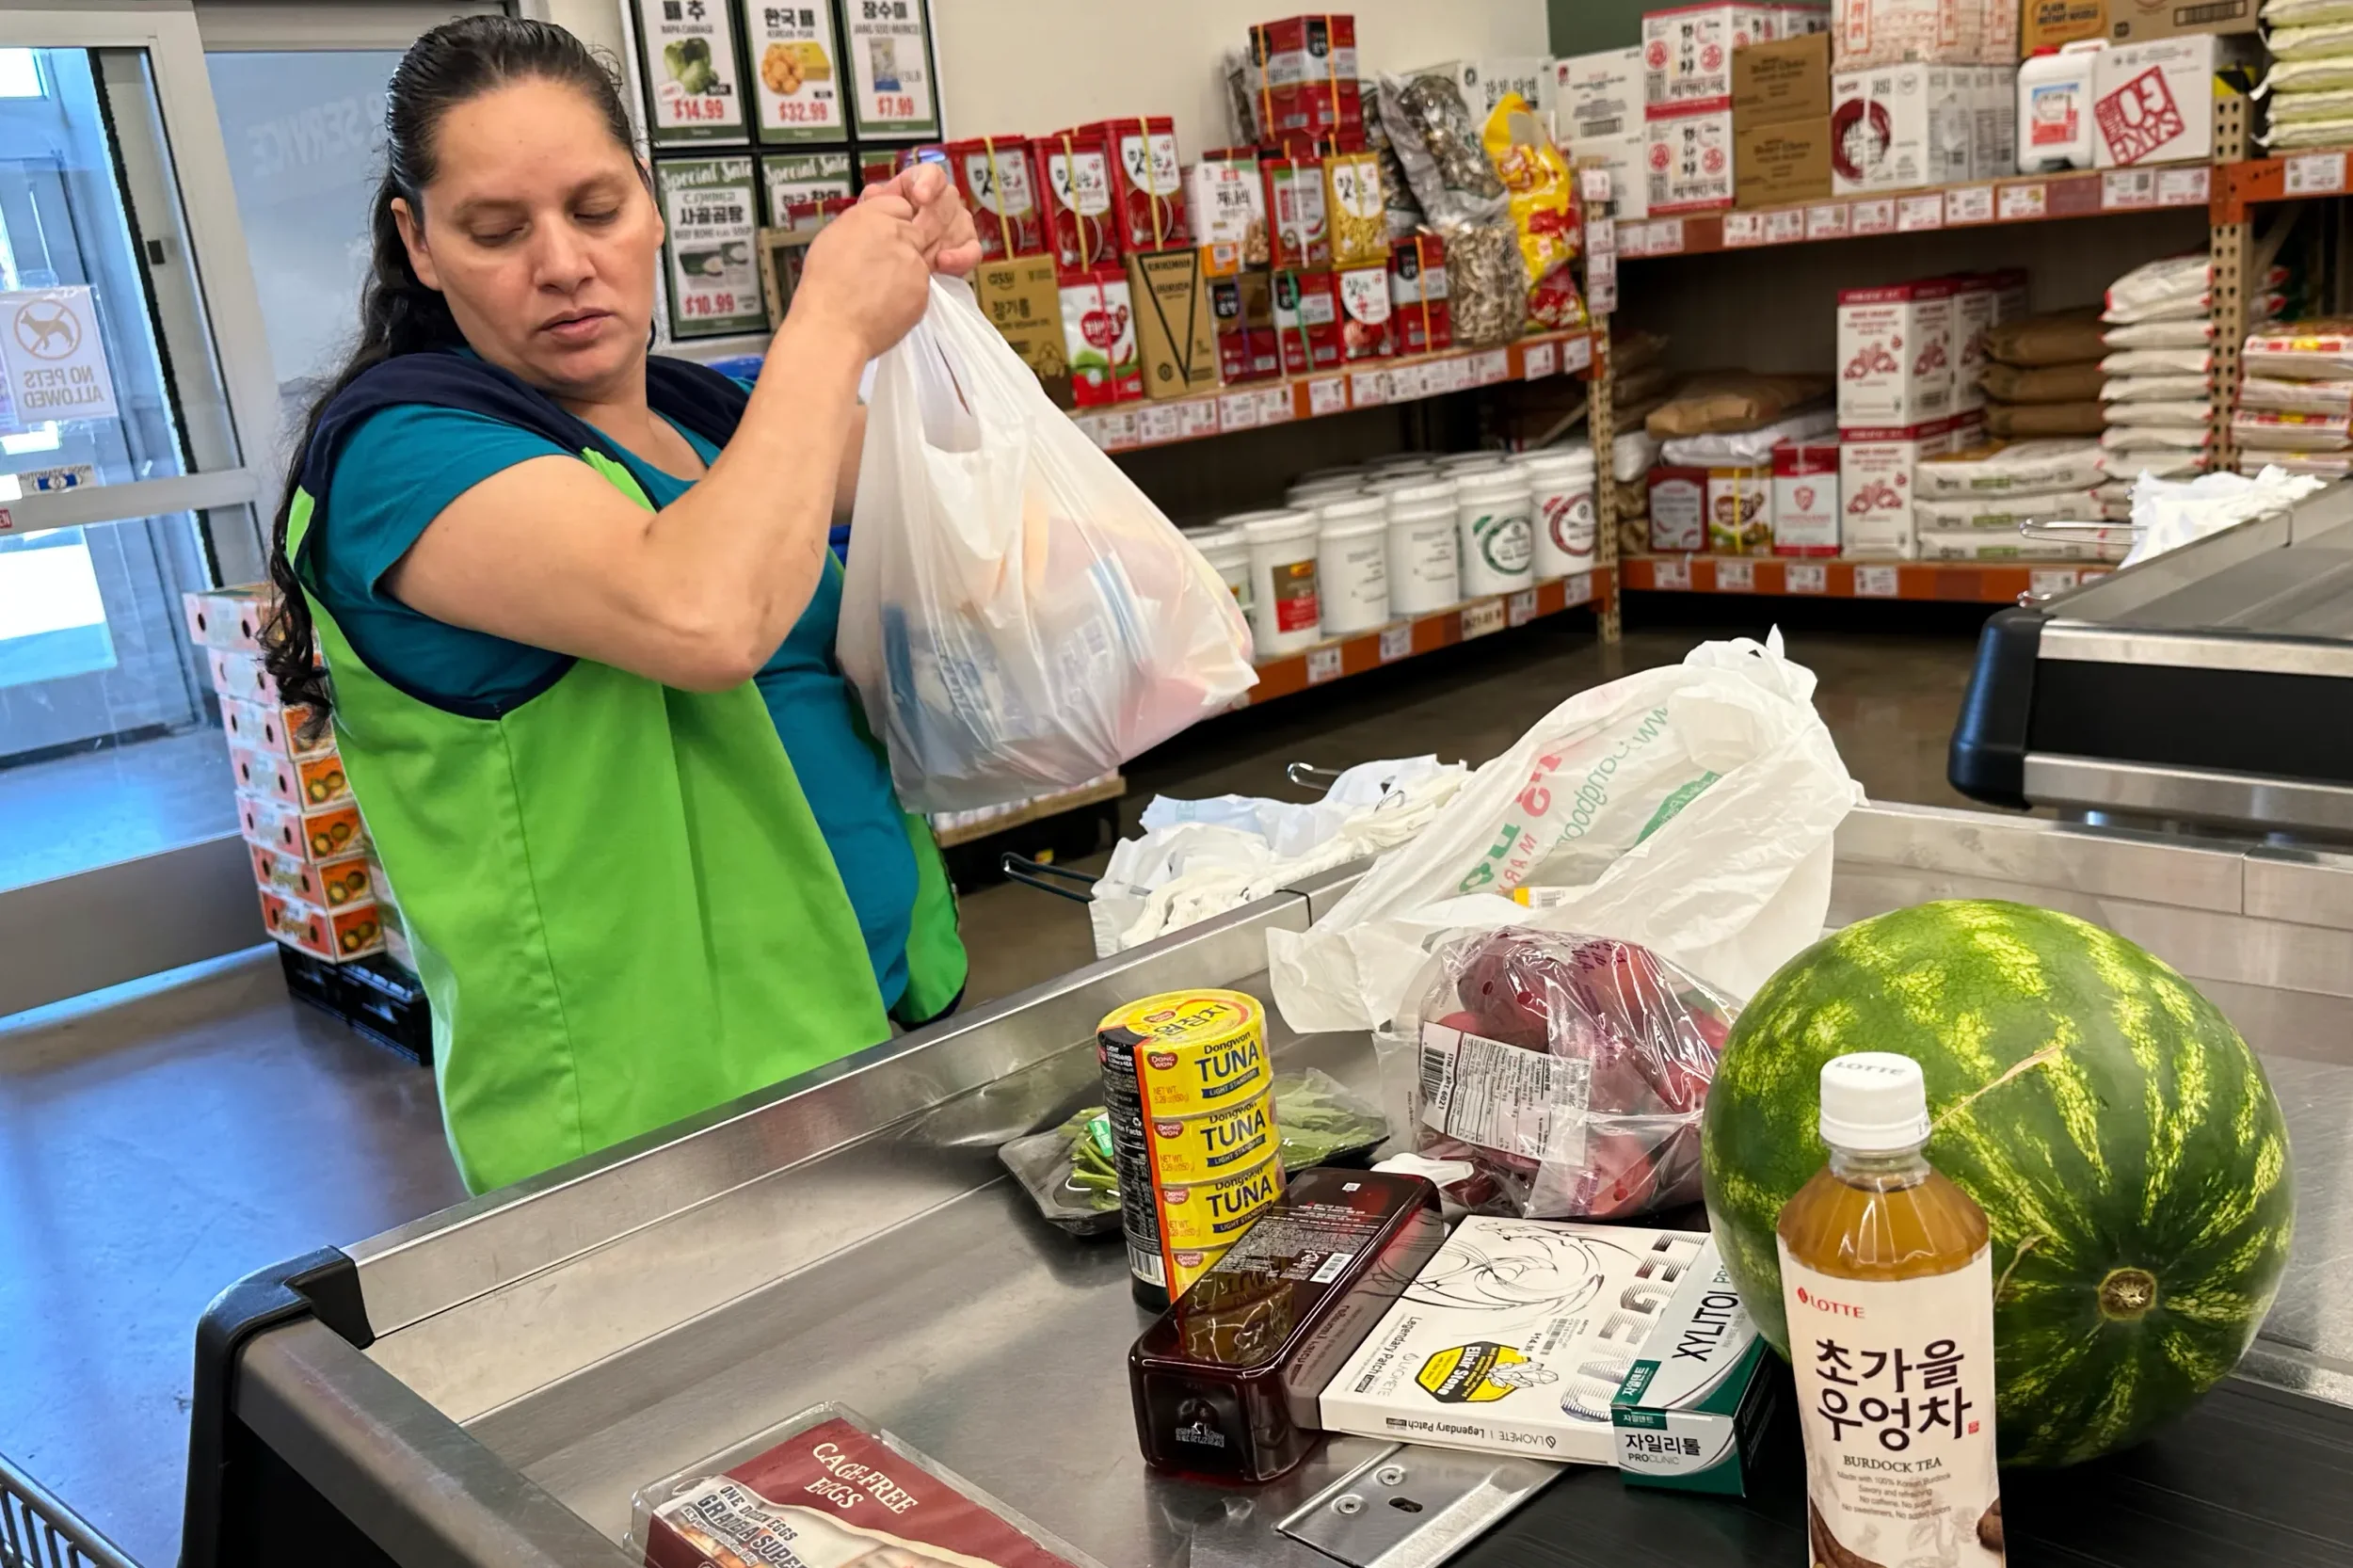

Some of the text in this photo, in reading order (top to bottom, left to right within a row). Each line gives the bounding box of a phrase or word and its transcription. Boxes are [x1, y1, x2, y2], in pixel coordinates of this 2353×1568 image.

[764, 8, 795, 27] 한국
[673, 98, 725, 120] $14.99
[876, 95, 915, 118] $7.99
[660, 160, 753, 191] Special Sale
[763, 154, 850, 186] Special Sale
[685, 293, 735, 316] $10.99
[1203, 1032, 1252, 1055] Dongwon
[1151, 1054, 1176, 1063] DONG
[1194, 1040, 1260, 1081] TUNA
[1446, 1053, 1454, 1068] ITM.
[1835, 1061, 1906, 1076] LOTTE
[1209, 1069, 1258, 1096] LIGHT STANDARD
[1438, 1091, 1448, 1110] 6021
[1160, 1128, 1179, 1137] WON
[1200, 1109, 1266, 1150] TUNA
[1214, 1154, 1234, 1165] LIGHT
[1206, 1175, 1273, 1217] TUNA
[1220, 1221, 1240, 1232] LIGHT
[1810, 1294, 1865, 1319] LOTTE
[1385, 1317, 1423, 1355] Legendary
[1369, 1352, 1395, 1375] Patch
[1436, 1346, 1482, 1396] Elixir Stone
[1816, 1338, 1964, 1393] 초가을
[1408, 1419, 1433, 1432] Patch
[1435, 1420, 1485, 1439] Legendary
[1817, 1385, 1973, 1451] 우엉차
[1625, 1432, 1701, 1456] 자일리톨
[1628, 1452, 1680, 1465] PROCLINIC
[1843, 1455, 1943, 1473] BURDOCK TEA
[811, 1442, 919, 1515] CAGE-FREE
[1875, 1477, 1896, 1485] 100%
[1897, 1479, 1922, 1488] Korean
[804, 1477, 864, 1510] EGGS
[1859, 1495, 1870, 1503] No
[696, 1493, 745, 1535] GRADE
[719, 1484, 746, 1509] ONE
[765, 1515, 799, 1543] EGGS
[1842, 1503, 1852, 1512] No
[1896, 1511, 1906, 1519] No
